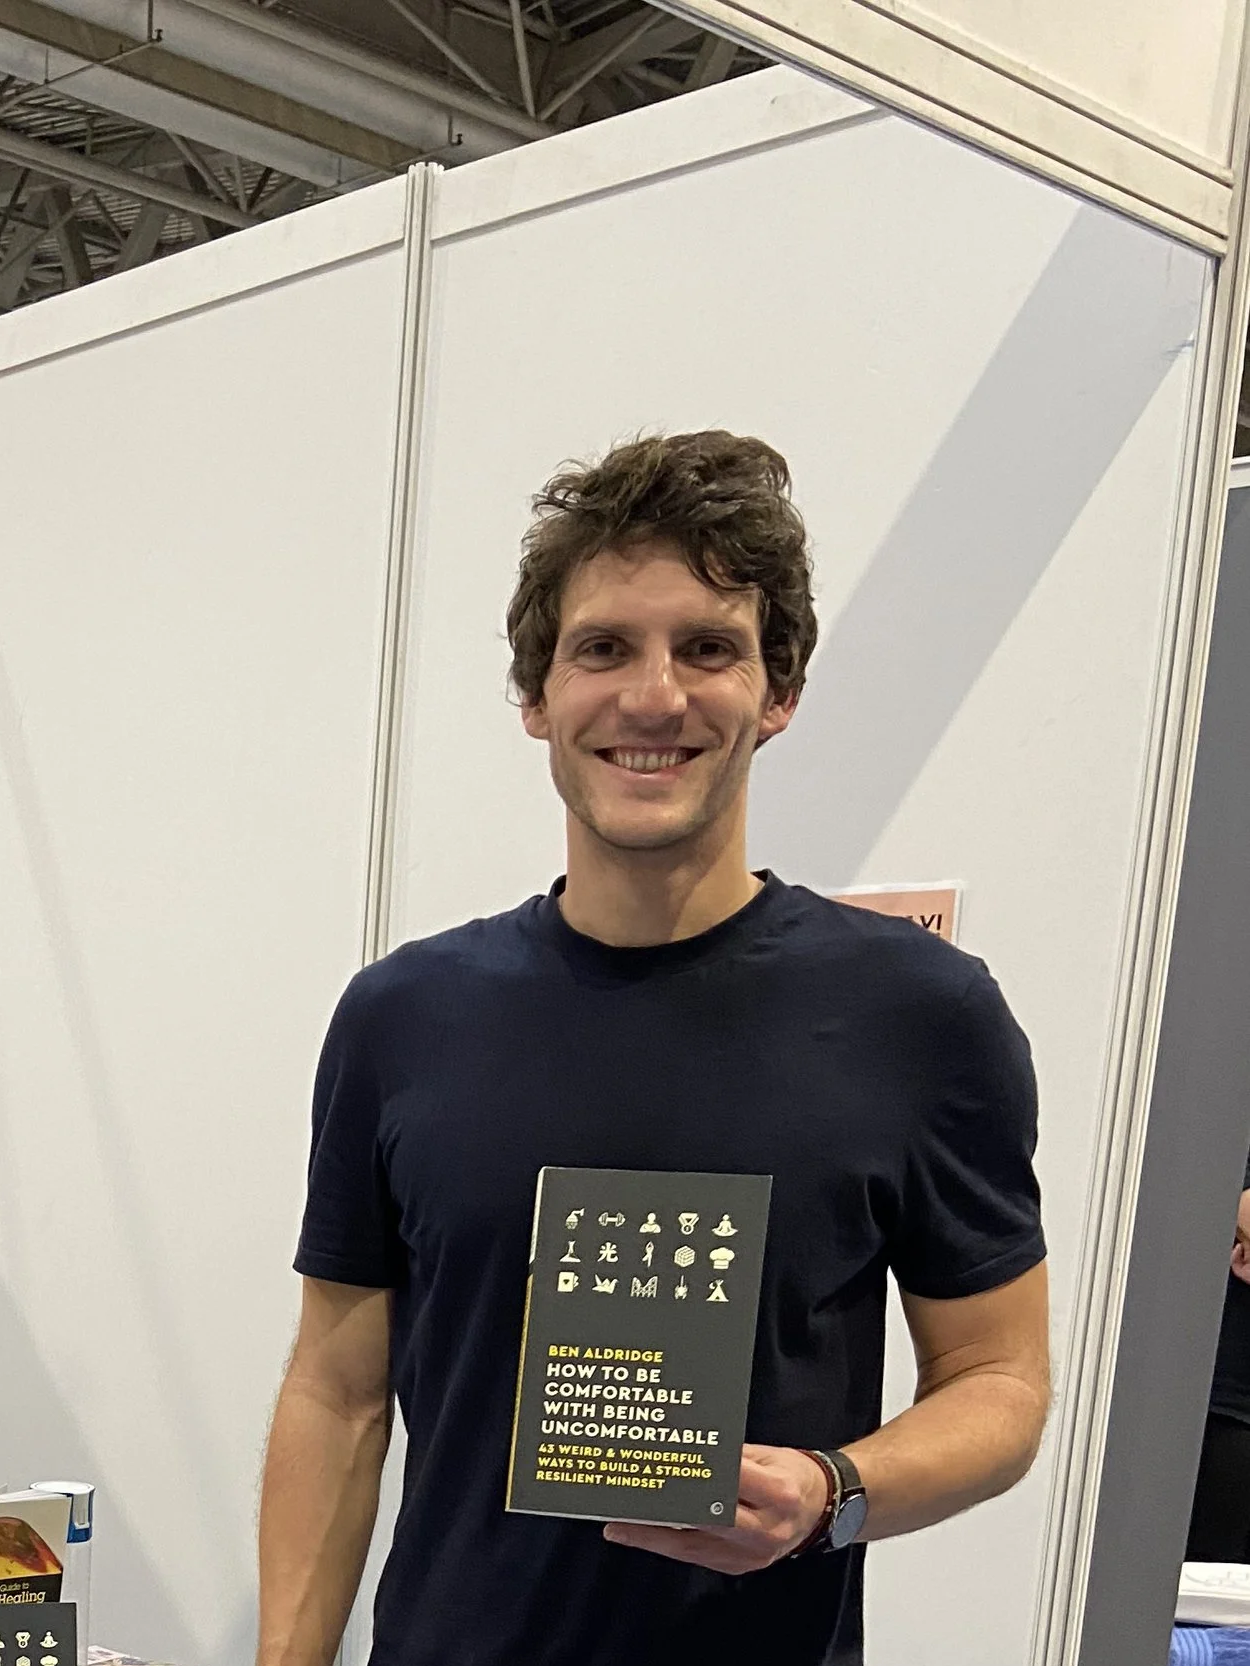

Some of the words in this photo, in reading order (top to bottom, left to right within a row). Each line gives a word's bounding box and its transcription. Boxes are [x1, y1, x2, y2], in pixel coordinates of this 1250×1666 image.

[549, 1346, 581, 1359] BEN
[584, 1347, 663, 1363] ALDRIDGE
[547, 1363, 597, 1379] HOW
[602, 1366, 629, 1381] TO
[636, 1368, 661, 1383] BE
[545, 1383, 693, 1405] COMFORTABLE
[544, 1402, 596, 1418] WITH
[603, 1405, 665, 1422] BEING
[541, 1421, 719, 1446] UNCOMFORTABLE
[539, 1444, 555, 1454] 43
[559, 1445, 602, 1457] WEIRD
[606, 1448, 614, 1458] &
[620, 1449, 705, 1464] WONDERFUL
[538, 1457, 573, 1469] WAYS
[577, 1459, 596, 1470] TO
[600, 1461, 639, 1474] BUILD
[642, 1464, 652, 1474] A
[655, 1465, 712, 1479] STRONG
[536, 1471, 603, 1485] RESILIENT
[606, 1475, 665, 1489] MINDSET
[0, 1583, 21, 1592] Guide
